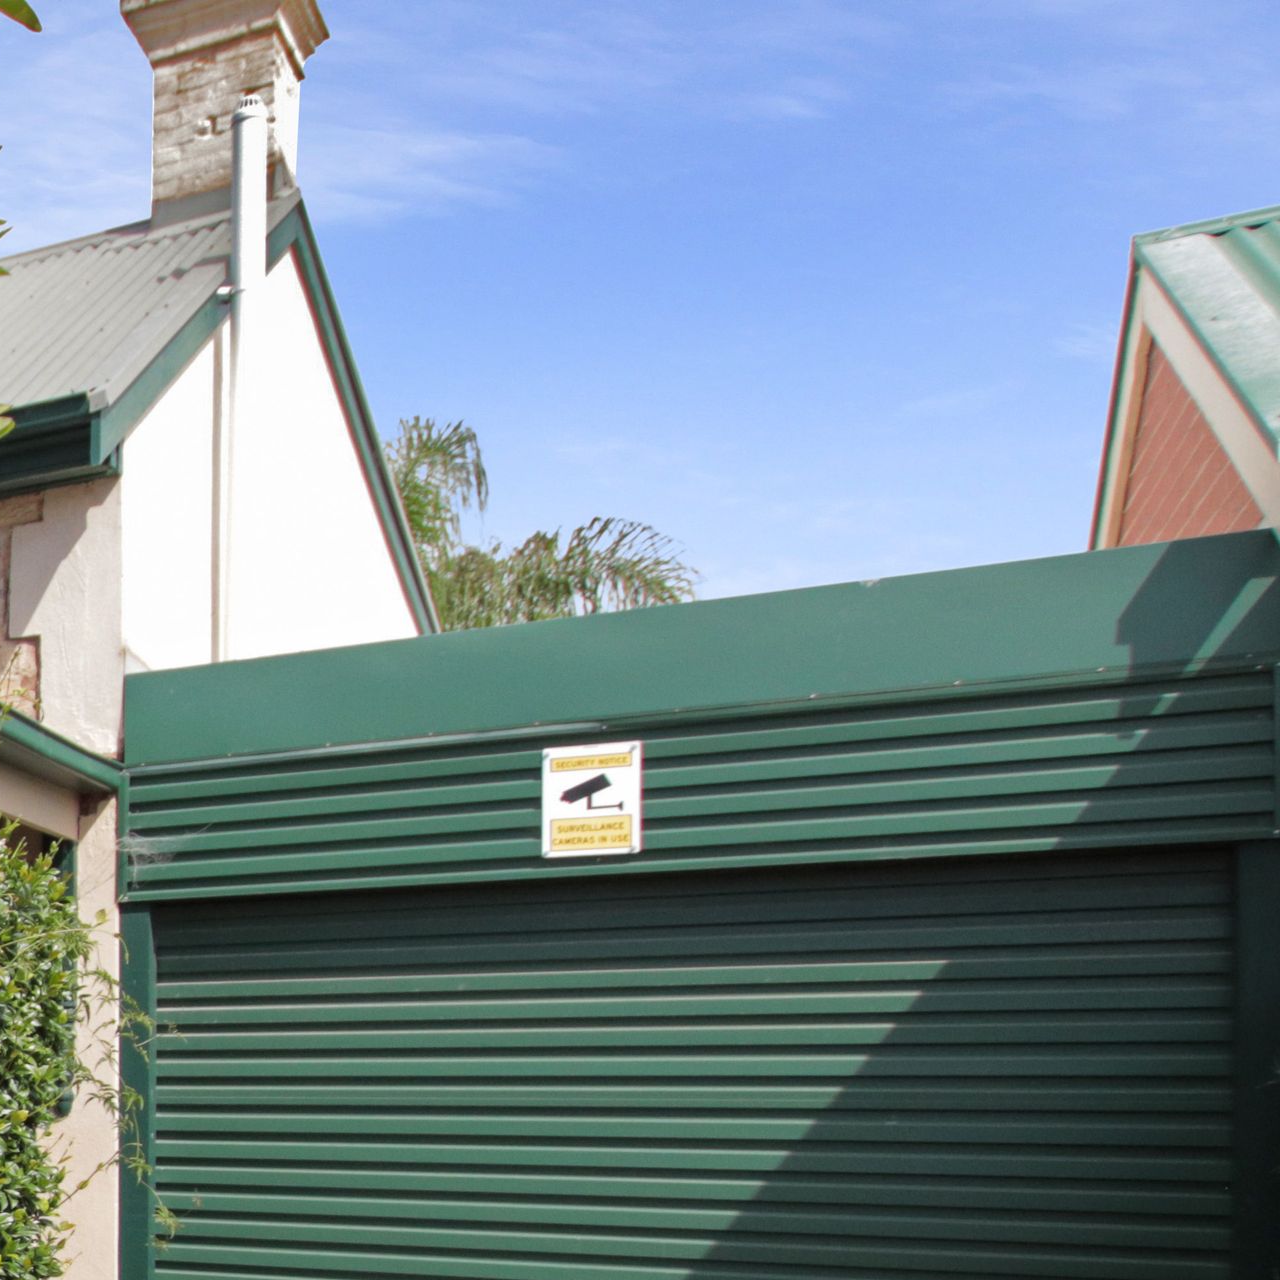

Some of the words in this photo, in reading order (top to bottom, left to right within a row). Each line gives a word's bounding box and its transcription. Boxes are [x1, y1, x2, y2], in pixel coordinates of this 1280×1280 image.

[555, 759, 595, 769] SECURITY
[598, 756, 627, 765] NOTICE
[557, 822, 624, 833] SURVEILLANCE
[552, 836, 595, 846] CAMERAS
[598, 835, 608, 843] IN
[611, 833, 629, 843] USE
